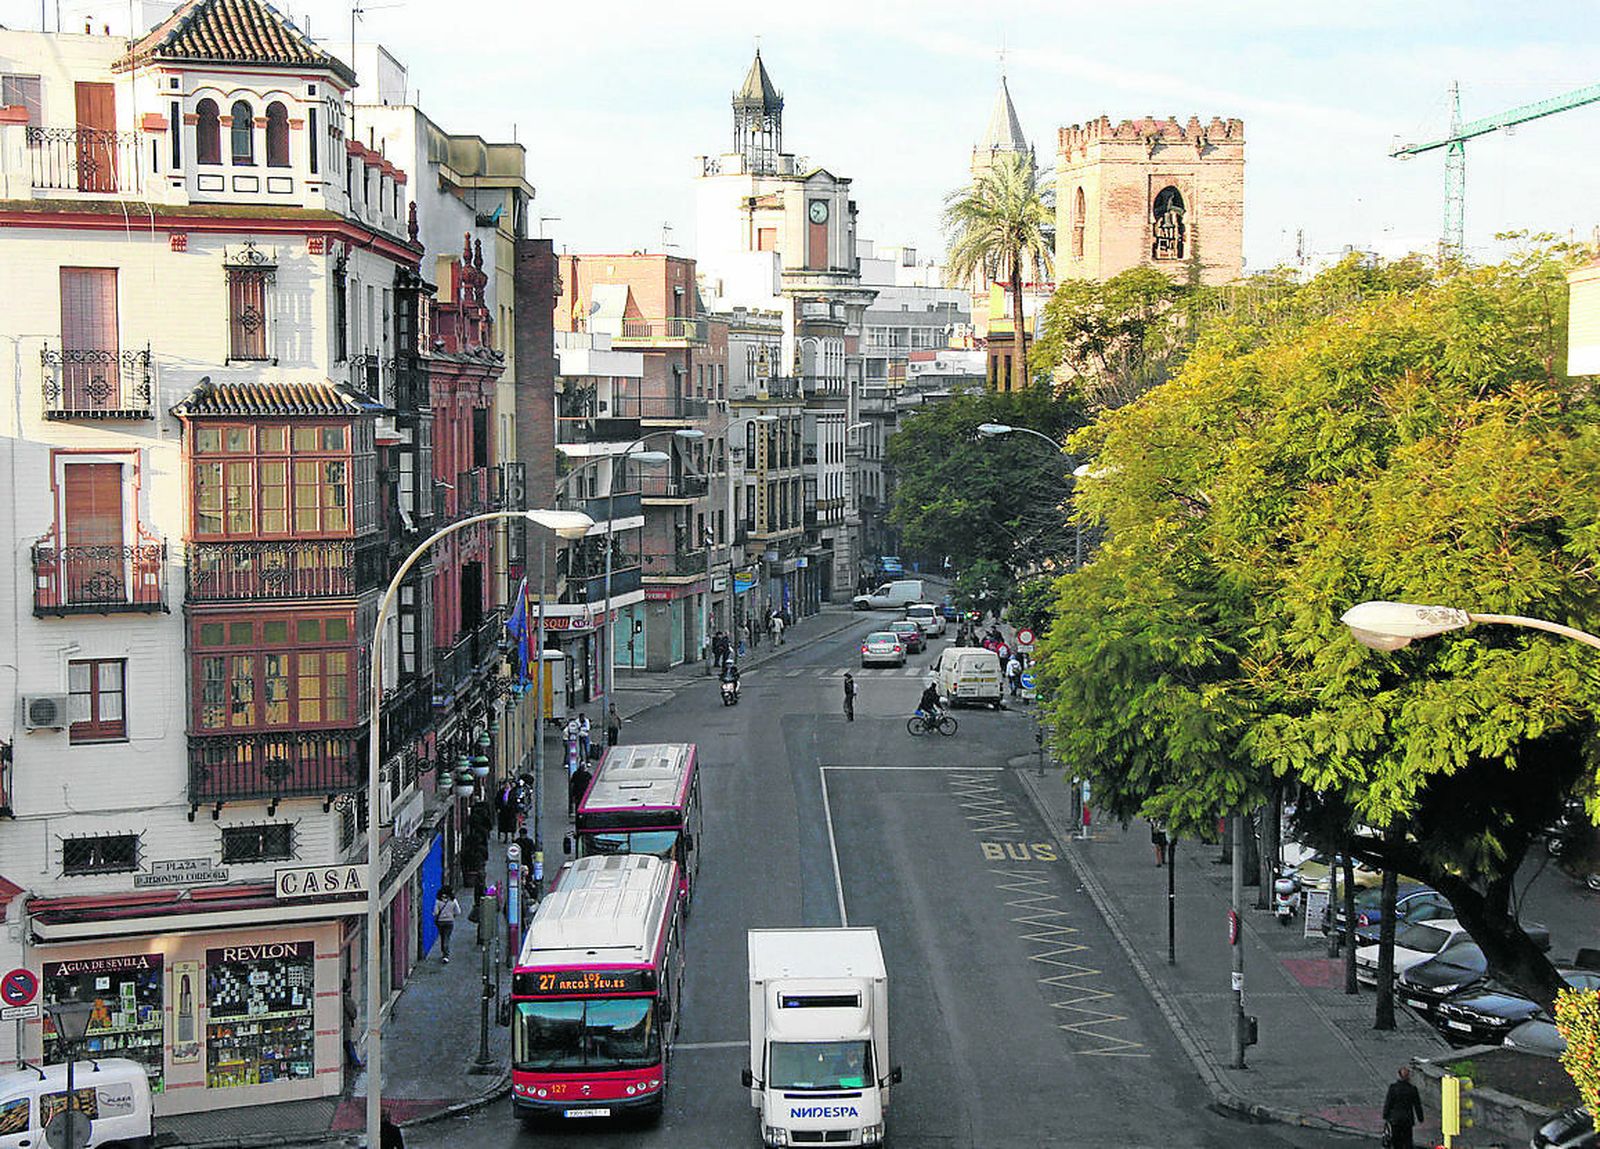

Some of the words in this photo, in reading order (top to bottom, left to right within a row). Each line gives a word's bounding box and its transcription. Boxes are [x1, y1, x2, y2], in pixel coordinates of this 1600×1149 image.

[980, 842, 1057, 861] BUS
[166, 862, 197, 871] PLAZA
[281, 867, 361, 894] CASA
[223, 943, 298, 962] REVLON
[56, 962, 89, 976] AGUA
[91, 960, 105, 970] DE
[107, 956, 150, 969] SEVILLA
[539, 974, 556, 990] 27
[559, 980, 590, 989] ARCOS
[583, 973, 600, 982] LOS
[551, 1084, 567, 1094] 127
